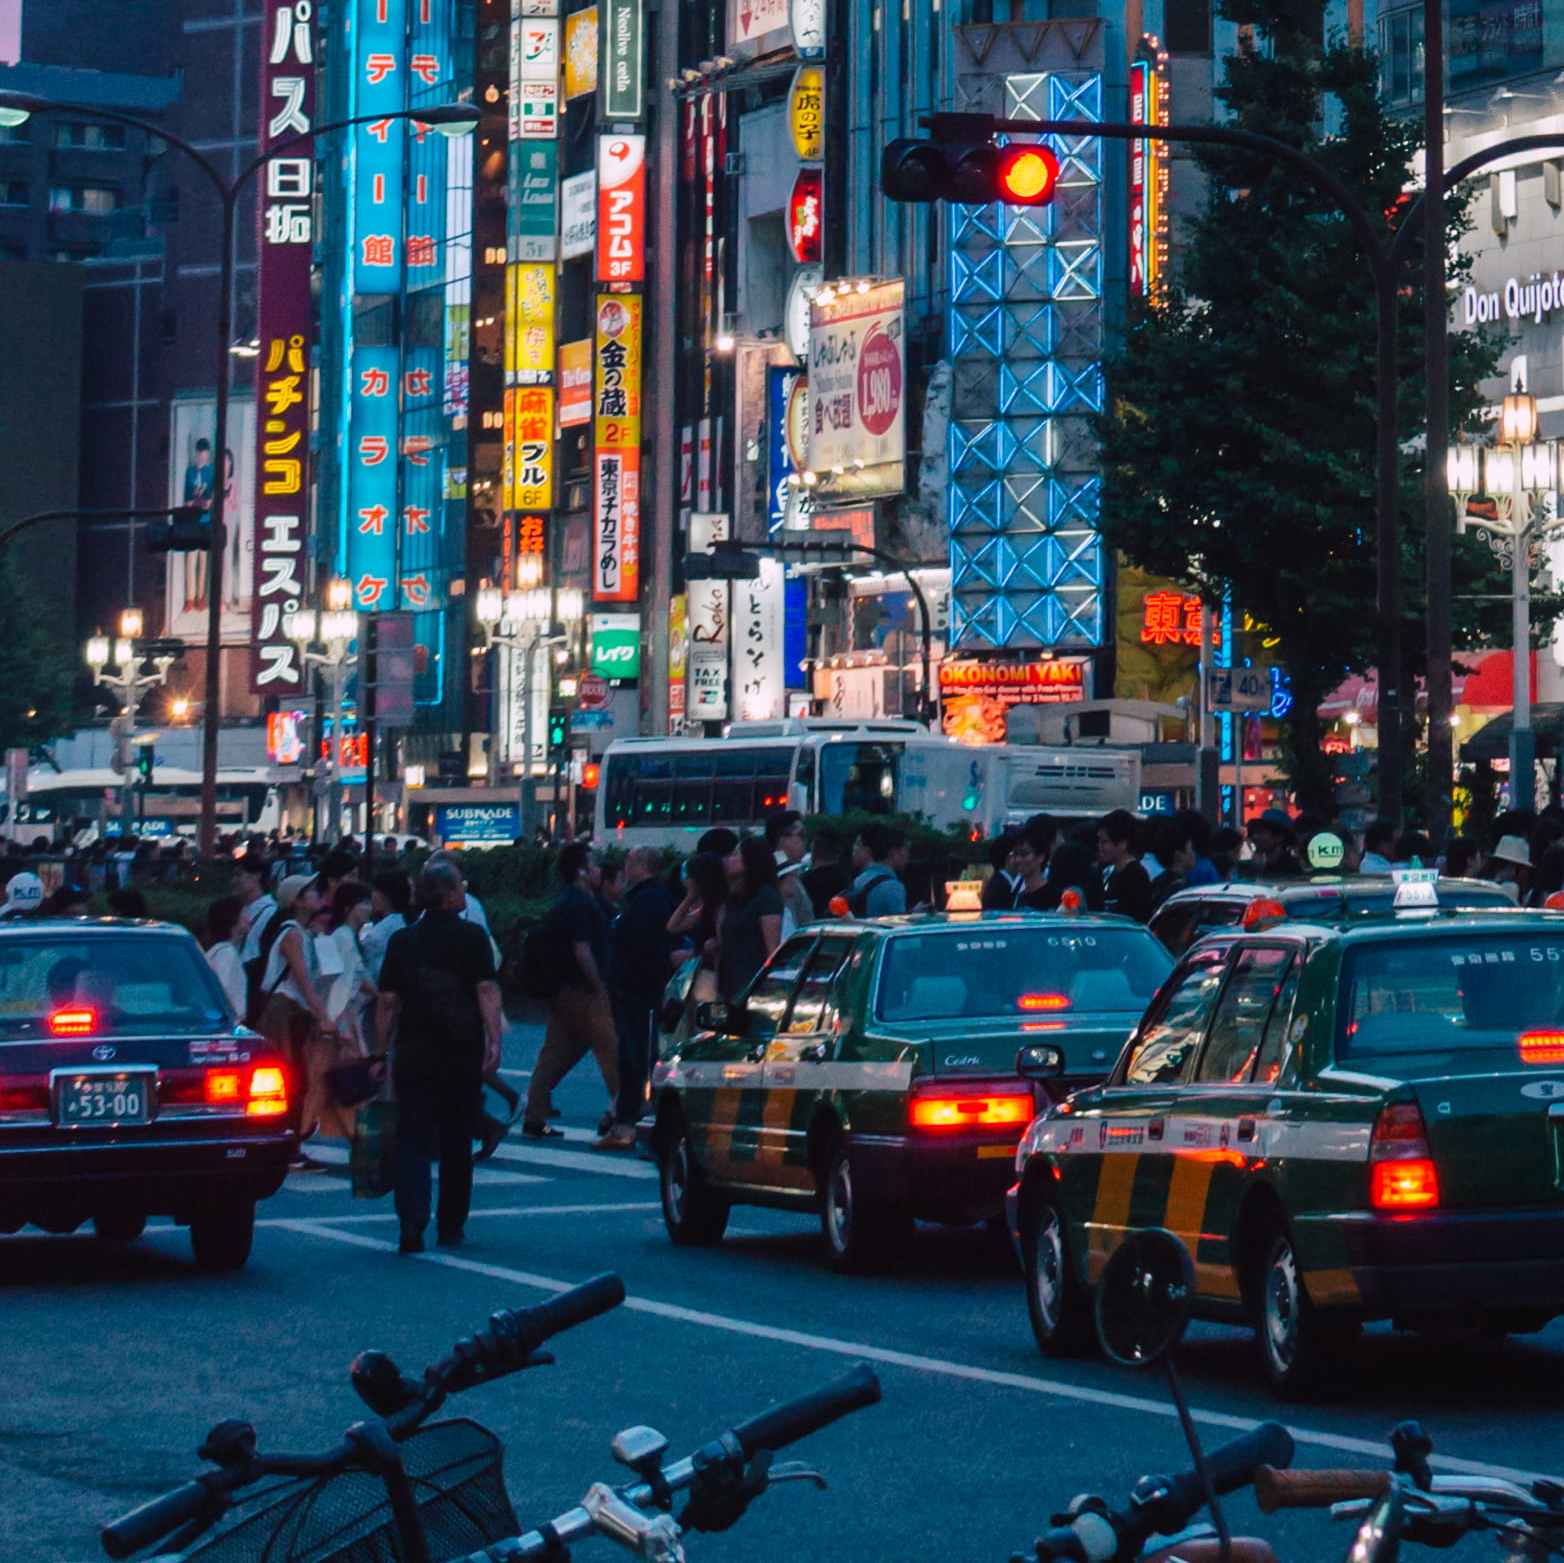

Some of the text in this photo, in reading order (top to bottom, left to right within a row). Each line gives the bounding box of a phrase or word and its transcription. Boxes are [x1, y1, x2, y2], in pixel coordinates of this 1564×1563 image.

[797, 93, 821, 141] 虎の子
[265, 158, 311, 244] 日拓
[608, 192, 634, 258] アコム
[610, 262, 631, 276] 3F
[1464, 285, 1499, 325] Don
[599, 340, 627, 417] 金の蔵
[264, 335, 305, 495] パチンコ
[814, 387, 855, 435] 食べ放題
[605, 424, 631, 442] 2F
[357, 368, 390, 606] カラオケ
[523, 490, 542, 505] 6F
[601, 458, 620, 590] 東京チカラめし
[256, 514, 301, 686] エスパス
[596, 645, 635, 664] レイク
[694, 668, 720, 677] TAX
[941, 664, 1082, 685] OKONOMI YAKI
[695, 678, 720, 687] FREE
[945, 1053, 981, 1067] Cedric
[80, 1094, 140, 1116] 53-00
